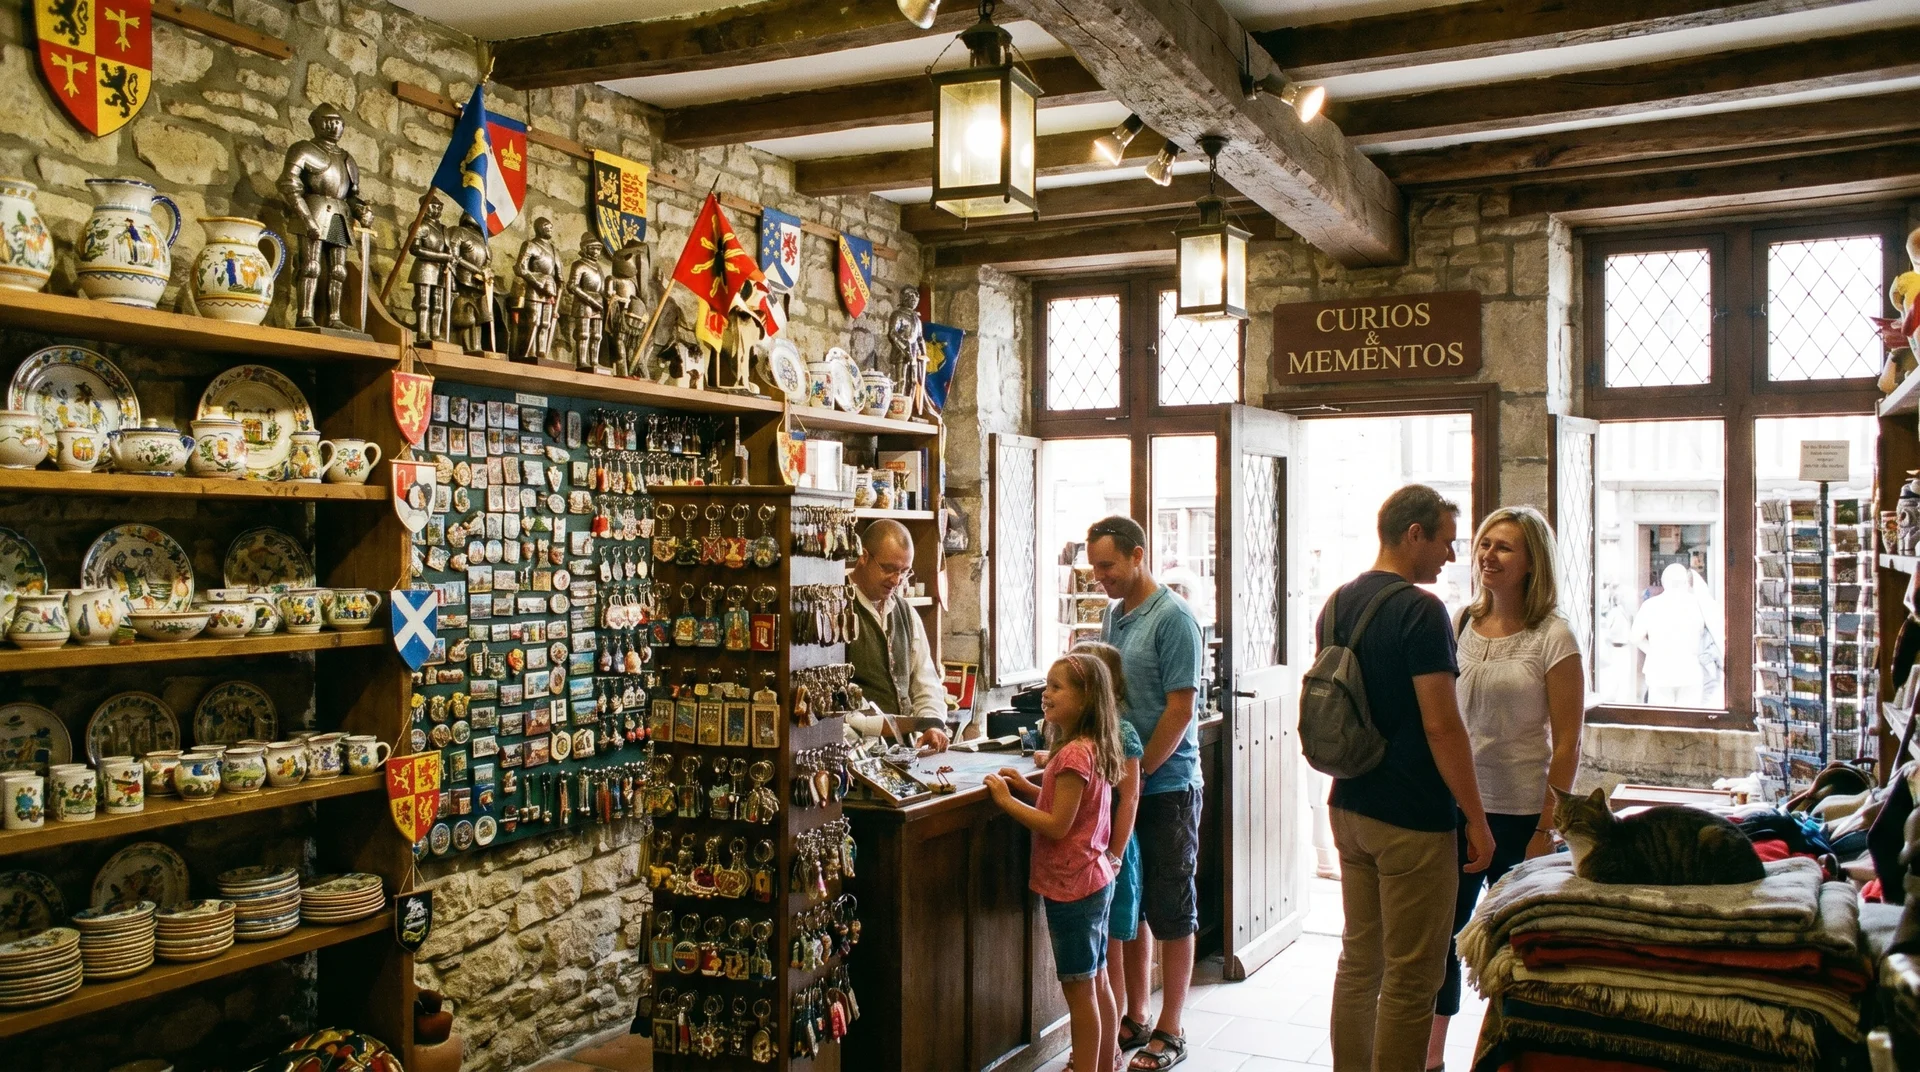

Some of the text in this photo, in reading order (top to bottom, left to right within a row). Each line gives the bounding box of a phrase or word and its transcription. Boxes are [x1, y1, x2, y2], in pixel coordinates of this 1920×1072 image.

[1316, 302, 1431, 333] CURIOS
[1365, 331, 1380, 346] &
[1287, 342, 1464, 375] MEMENTOS
